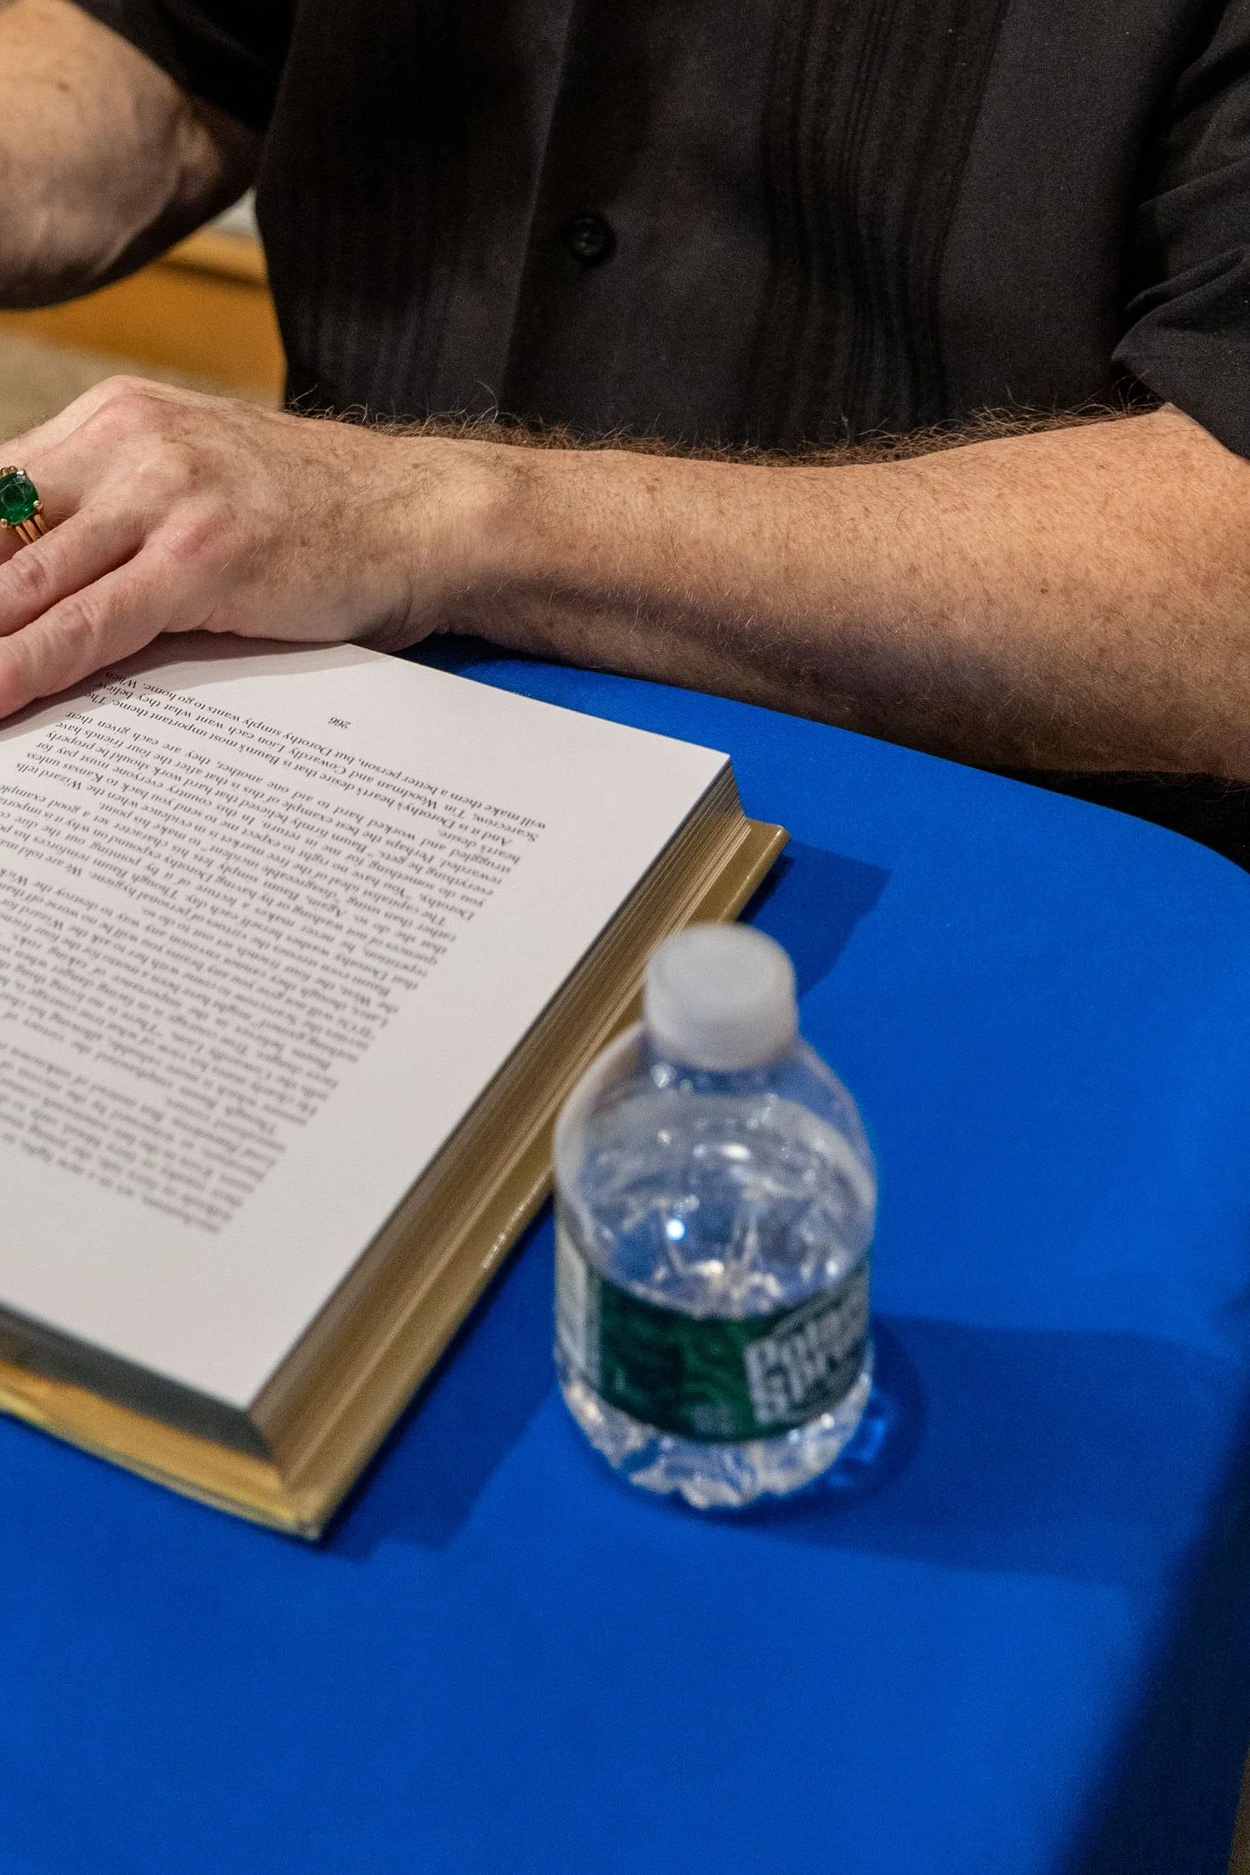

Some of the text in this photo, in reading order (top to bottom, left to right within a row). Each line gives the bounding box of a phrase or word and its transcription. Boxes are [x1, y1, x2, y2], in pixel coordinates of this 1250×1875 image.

[109, 673, 137, 689] When
[84, 690, 107, 706] The
[143, 683, 177, 701] home.
[111, 699, 149, 717] theme.
[208, 706, 240, 722] wants
[150, 713, 208, 736] important
[242, 717, 282, 736] simply
[328, 717, 351, 729] 266
[209, 733, 238, 747] most
[283, 732, 333, 756] Dorothy
[95, 681, 535, 842] Scarecrow, Tin Woodman and Cowardly Lion each want what they believe
[239, 744, 280, 765] Baum's
[334, 751, 355, 765] but
[293, 764, 318, 778] that
[358, 758, 403, 779] person,
[319, 774, 355, 791] desire
[403, 776, 439, 795] better
[357, 787, 395, 807] heart's
[450, 793, 483, 809] them
[397, 802, 455, 829] Dorothy's
[485, 805, 520, 821] make
[520, 817, 546, 829] will
[481, 832, 506, 846] And
